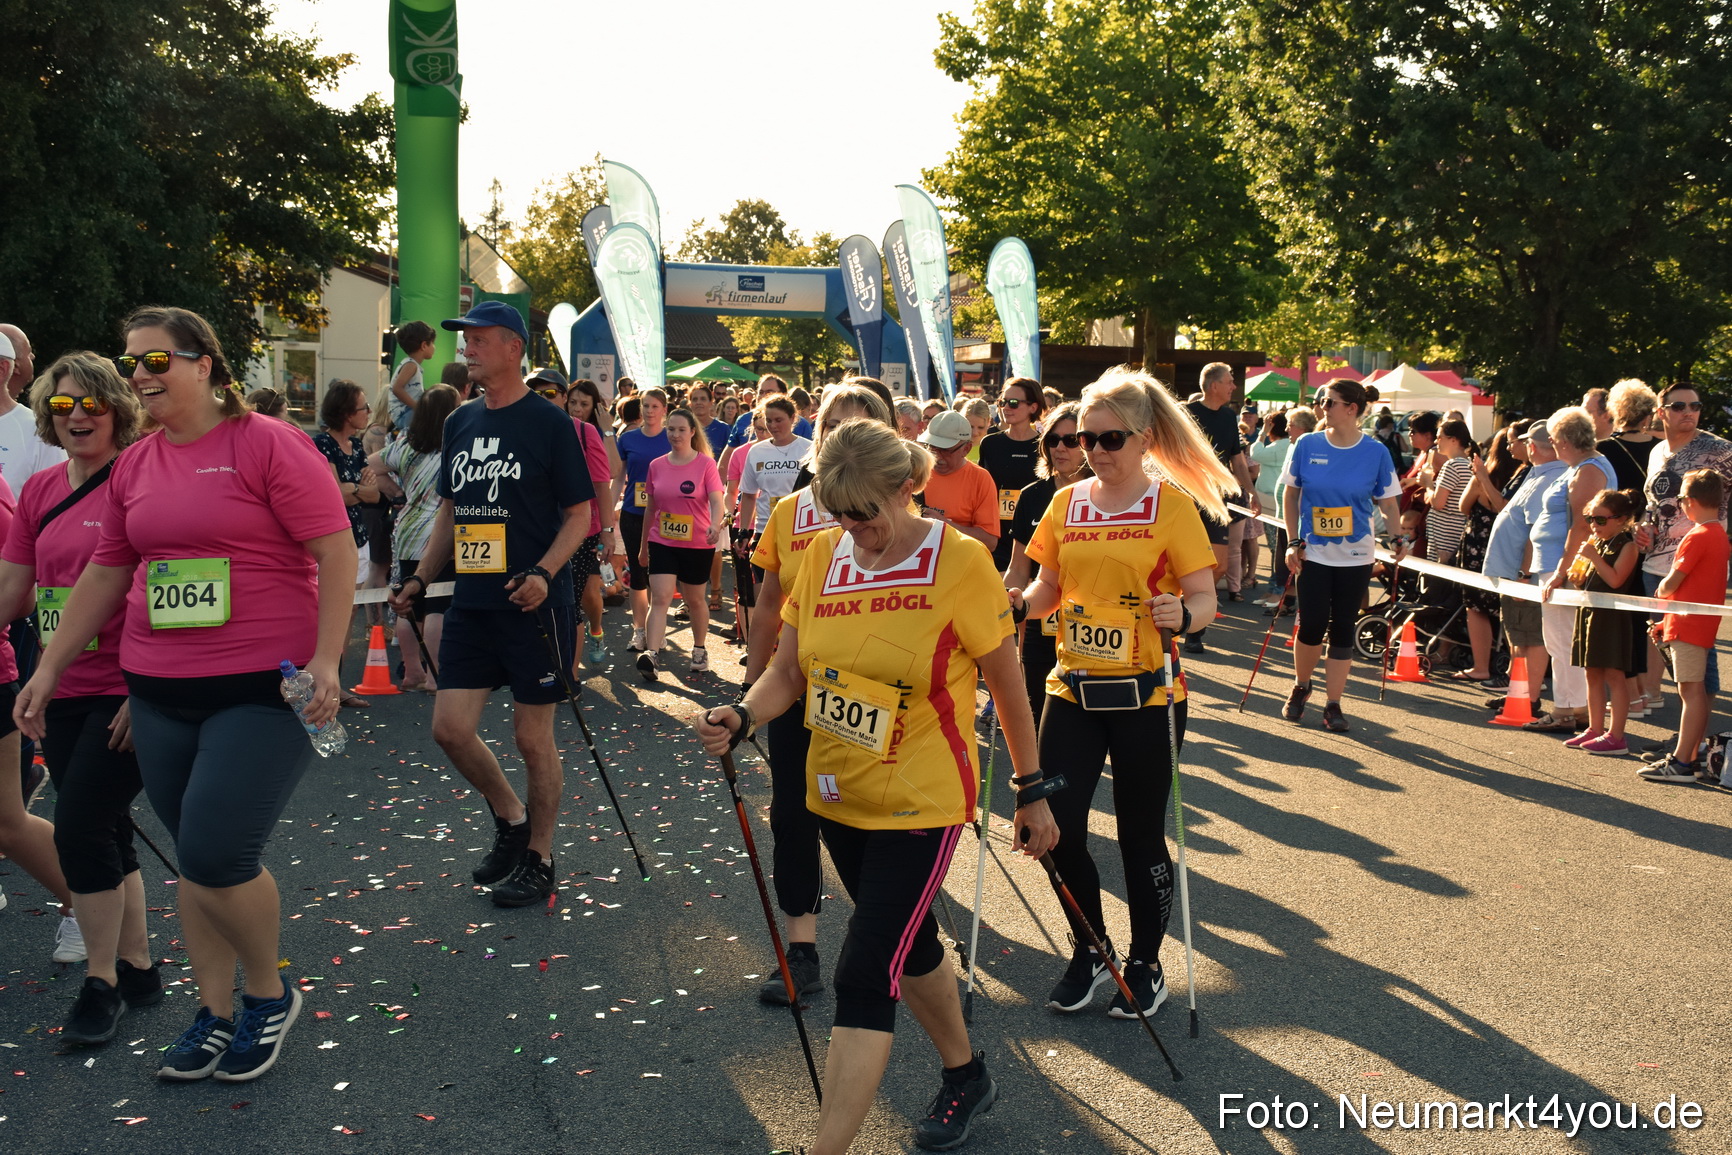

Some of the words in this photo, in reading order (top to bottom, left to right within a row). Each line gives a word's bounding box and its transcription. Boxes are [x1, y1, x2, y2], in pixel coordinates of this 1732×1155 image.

[728, 291, 788, 305] firmenlauf
[451, 450, 522, 503] Burgis
[663, 521, 689, 534] 1440
[1320, 517, 1344, 529] 810
[791, 538, 815, 553] MA
[1062, 530, 1101, 545] MAX
[1106, 527, 1155, 542] BÖGL
[461, 541, 491, 560] 272
[153, 583, 218, 610] 2064
[813, 599, 863, 618] MAX
[869, 591, 933, 613] BÖGL
[42, 609, 61, 632] 20
[1069, 622, 1124, 651] 1300
[1073, 643, 1091, 653] Fuchs
[1090, 646, 1117, 656] Angelika
[816, 689, 880, 735] 1301
[814, 712, 859, 737] Huber-Pöhner
[858, 731, 879, 745] Maria
[1149, 861, 1171, 887] BE
